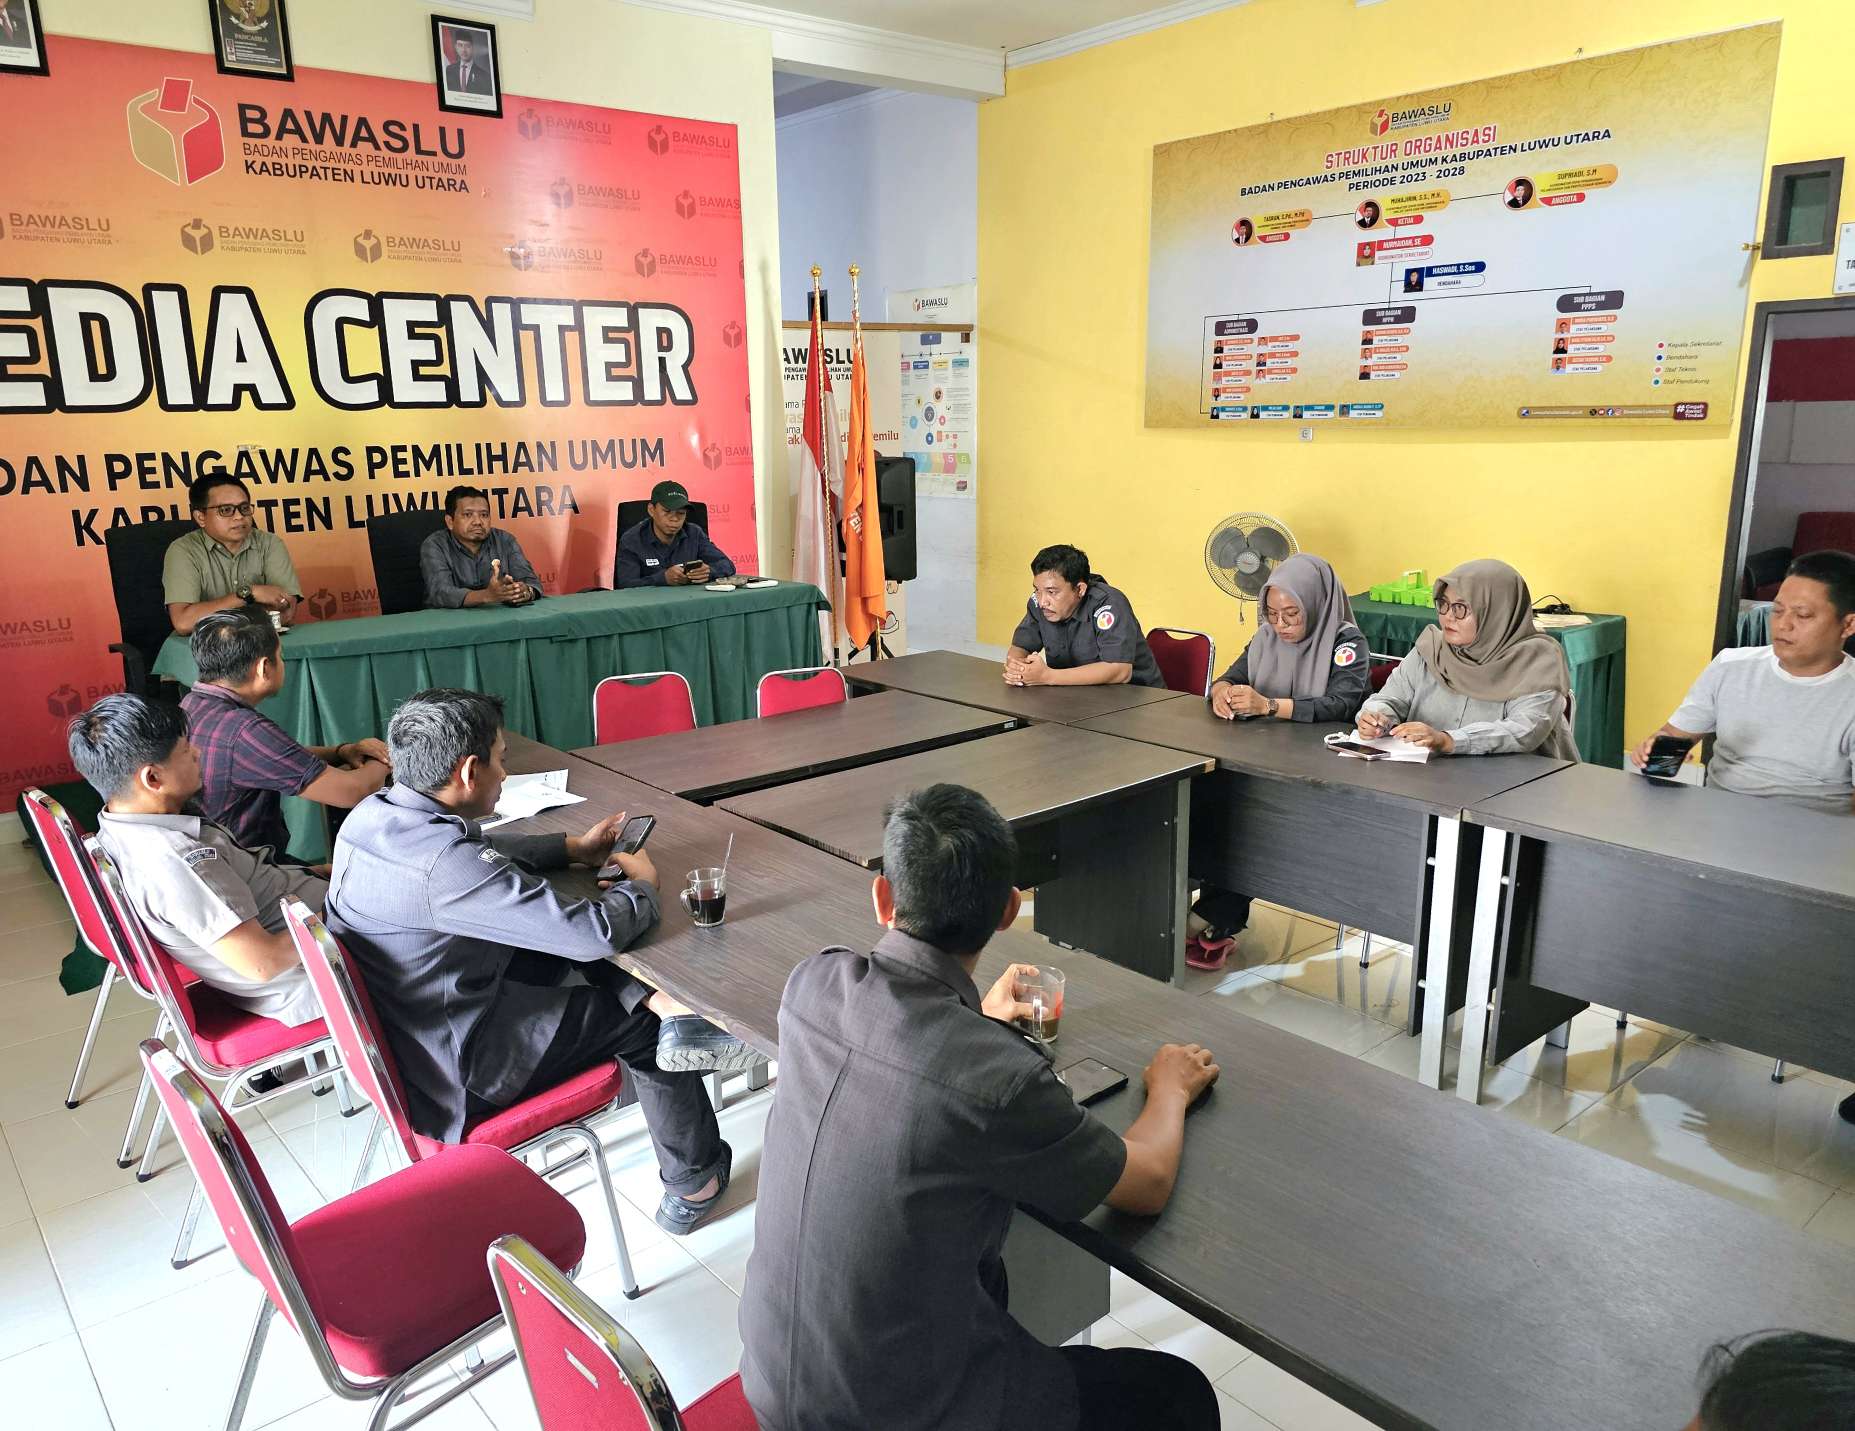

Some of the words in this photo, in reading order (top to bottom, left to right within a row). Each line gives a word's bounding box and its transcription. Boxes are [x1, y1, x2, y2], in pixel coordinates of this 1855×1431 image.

[1391, 102, 1452, 123] BAWASLU
[237, 103, 466, 160] BAWASLU
[545, 116, 612, 135] BAWASLU
[672, 131, 730, 149] BAWASLU
[1325, 142, 1399, 170] STRUKTUR
[1403, 125, 1497, 157] ORGANISASI
[243, 142, 288, 159] BADAN
[292, 147, 363, 166] PENGAWAS
[366, 154, 429, 172] PEMILIHAN
[432, 162, 467, 176] UMUM
[1240, 182, 1275, 197] BADAN
[1277, 172, 1336, 190] PENGAWAS
[1338, 161, 1399, 181] PEMILIHAN
[1401, 156, 1438, 171] UMUM
[1440, 143, 1518, 165] KABUPATEN
[1520, 136, 1562, 154] LUWU
[1563, 129, 1612, 145] UTARA
[244, 159, 355, 184] KABUPATEN
[360, 170, 409, 188] LUWU
[415, 175, 470, 194] UTARA
[1348, 176, 1397, 192] PERIODE
[1399, 171, 1427, 185] 2023
[1436, 165, 1465, 179] 2028
[576, 183, 641, 201] BAWASLU
[9, 212, 111, 232] BAWASLU
[218, 225, 305, 243] BAWASLU
[386, 235, 461, 252] BAWASLU
[659, 254, 717, 268] BAWASLU
[921, 297, 948, 308] BAWASLU
[305, 288, 698, 410] CENTER
[873, 430, 899, 441] emilu
[104, 445, 354, 492] PENGAWAS
[365, 440, 558, 480] PEMILIHAN
[568, 437, 665, 471] UMUM
[490, 484, 580, 520] TARA
